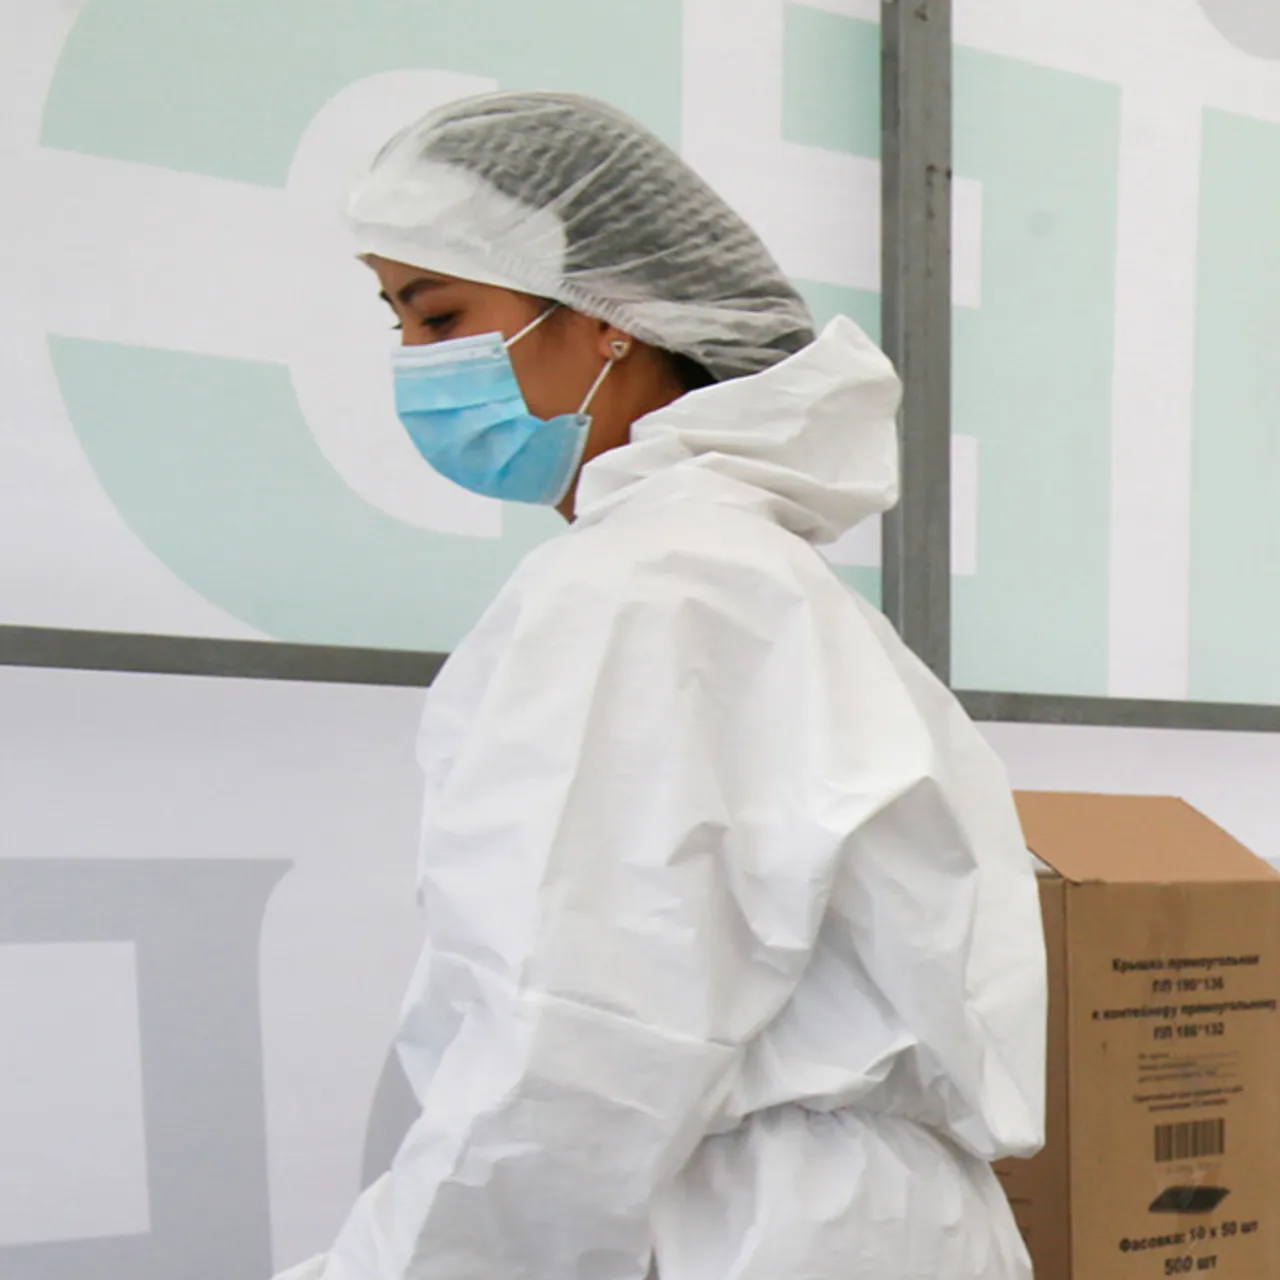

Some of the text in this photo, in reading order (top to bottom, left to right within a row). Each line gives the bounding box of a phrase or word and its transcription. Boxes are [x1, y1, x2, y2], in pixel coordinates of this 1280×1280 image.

[1119, 1232, 1186, 1252] Фасовка:
[1221, 1220, 1238, 1236] 50
[1241, 1219, 1259, 1234] шт
[1164, 1254, 1218, 1276] 500 шт
